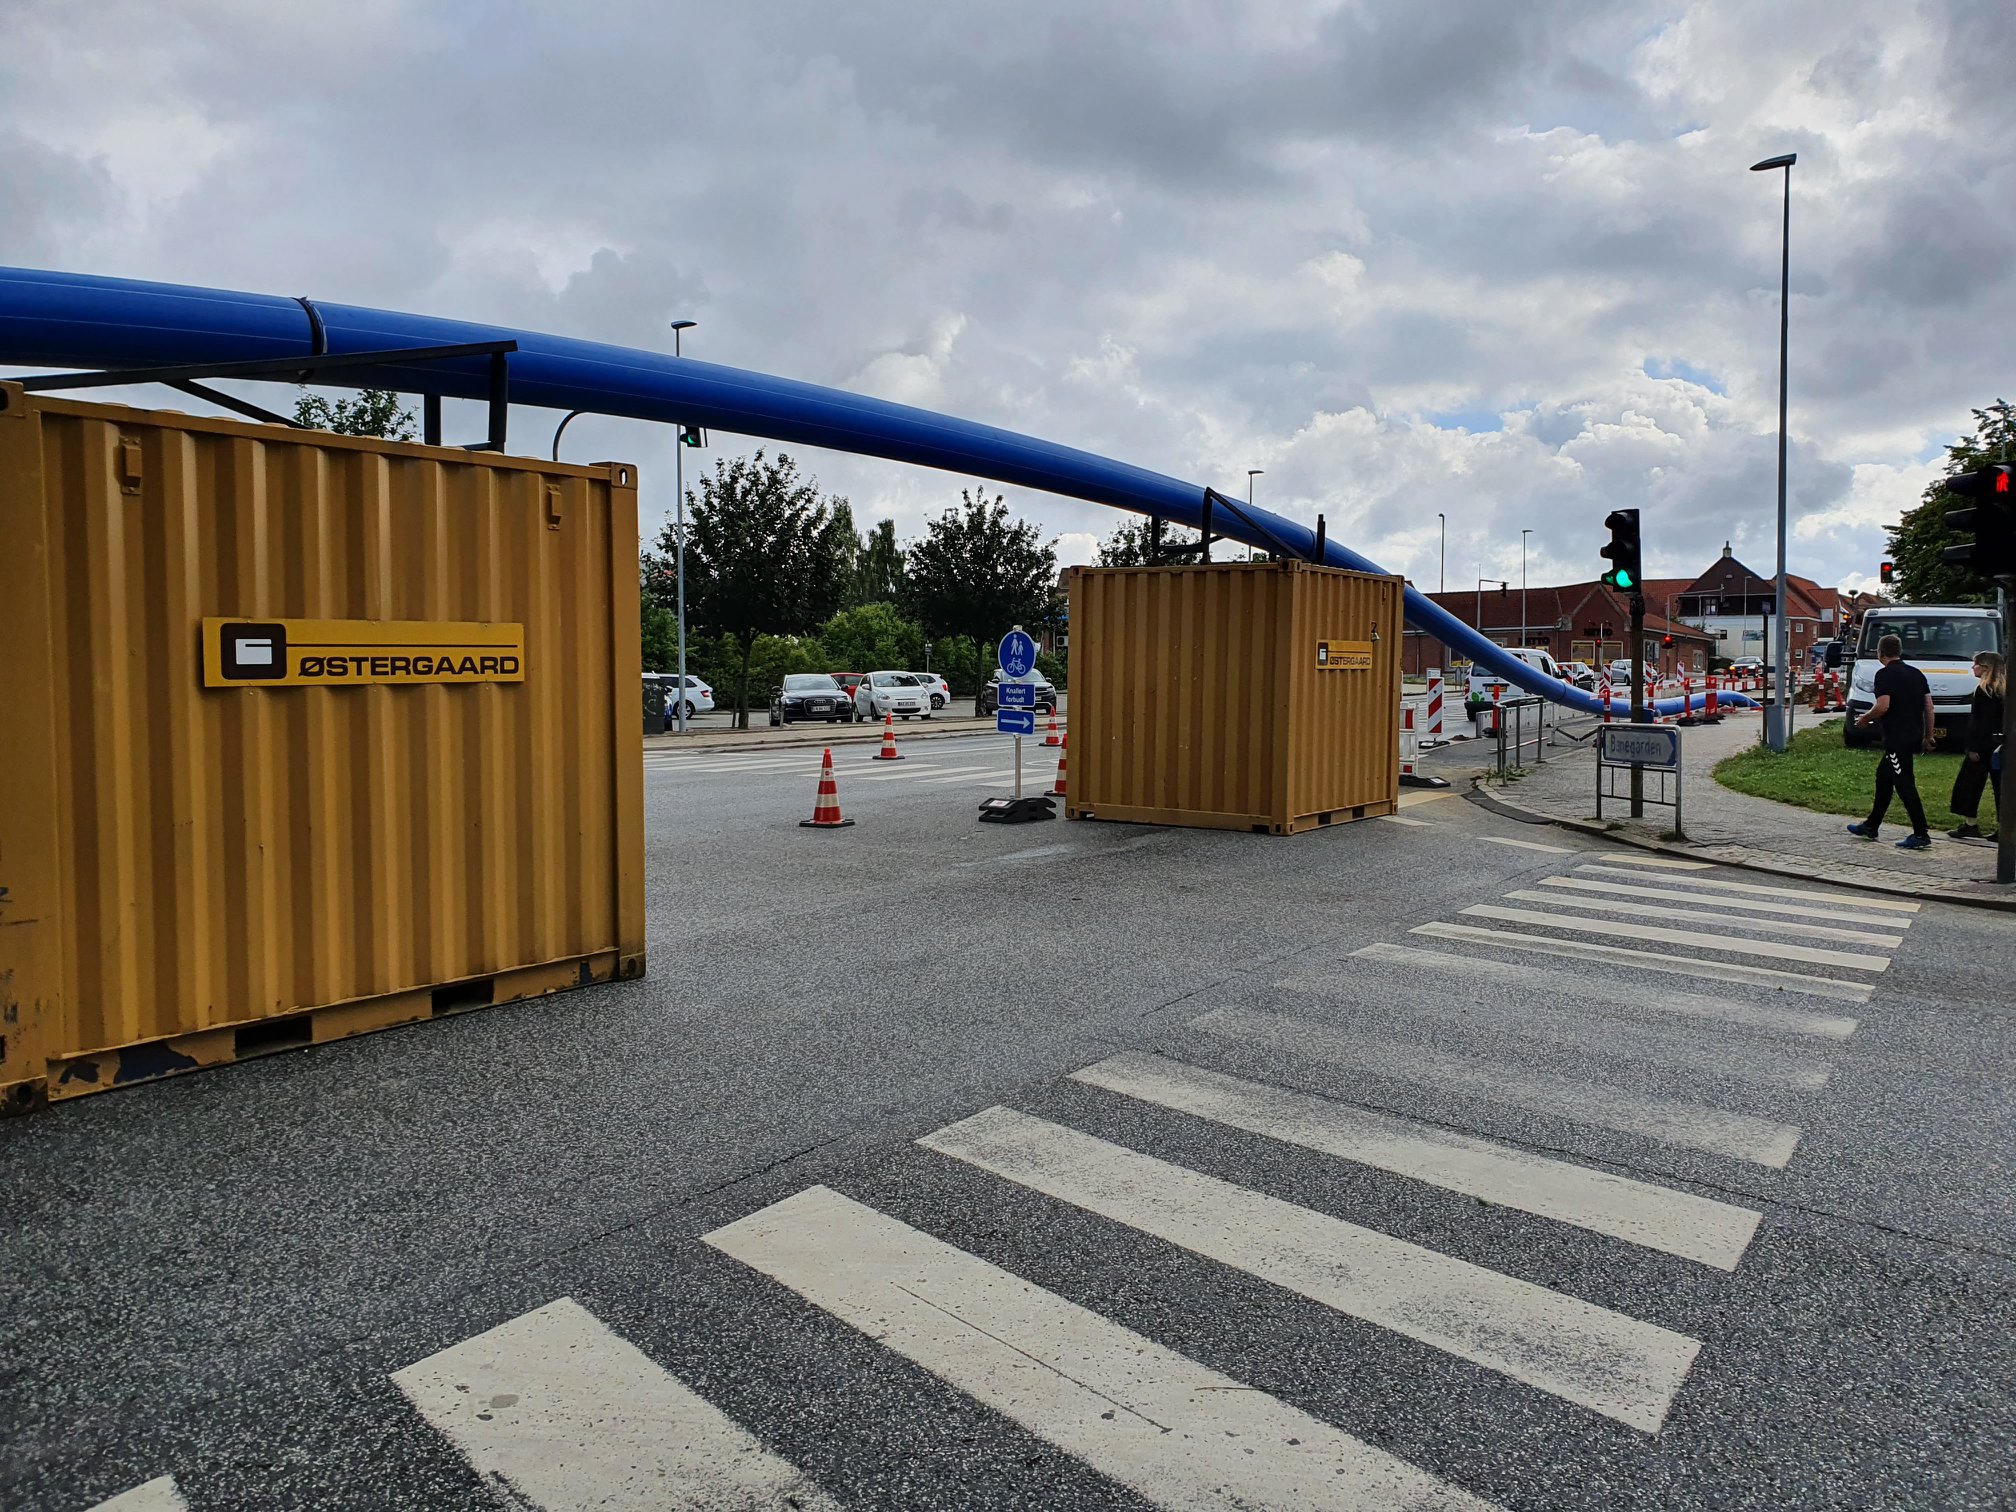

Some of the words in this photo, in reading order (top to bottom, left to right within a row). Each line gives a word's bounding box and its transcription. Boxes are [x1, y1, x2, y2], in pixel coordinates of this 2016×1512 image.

[1330, 656, 1370, 666] ØSTERGAARD
[298, 655, 519, 677] ØSTERGAARD
[1006, 687, 1025, 695] Knallert
[1006, 695, 1024, 703] forbudt
